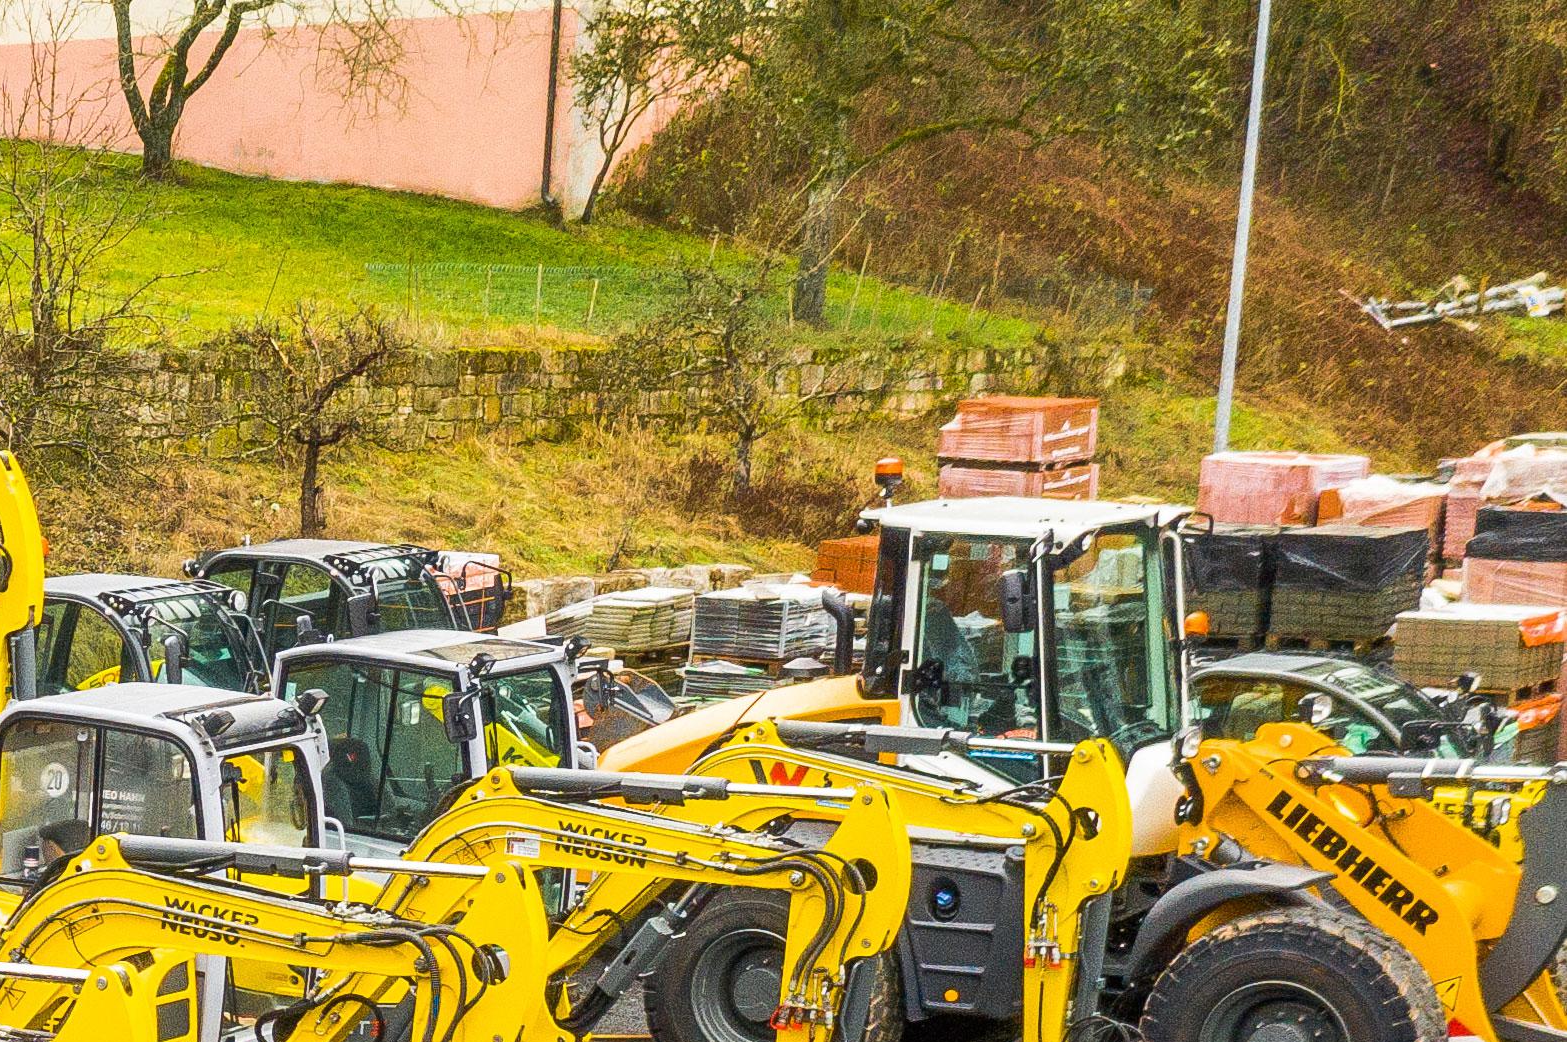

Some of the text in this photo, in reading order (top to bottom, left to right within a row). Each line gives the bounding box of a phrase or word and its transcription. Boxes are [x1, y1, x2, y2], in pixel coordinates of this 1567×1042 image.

[46, 769, 62, 791] 20
[1266, 790, 1439, 936] LIEBHERR
[161, 910, 245, 948] NEUSO
